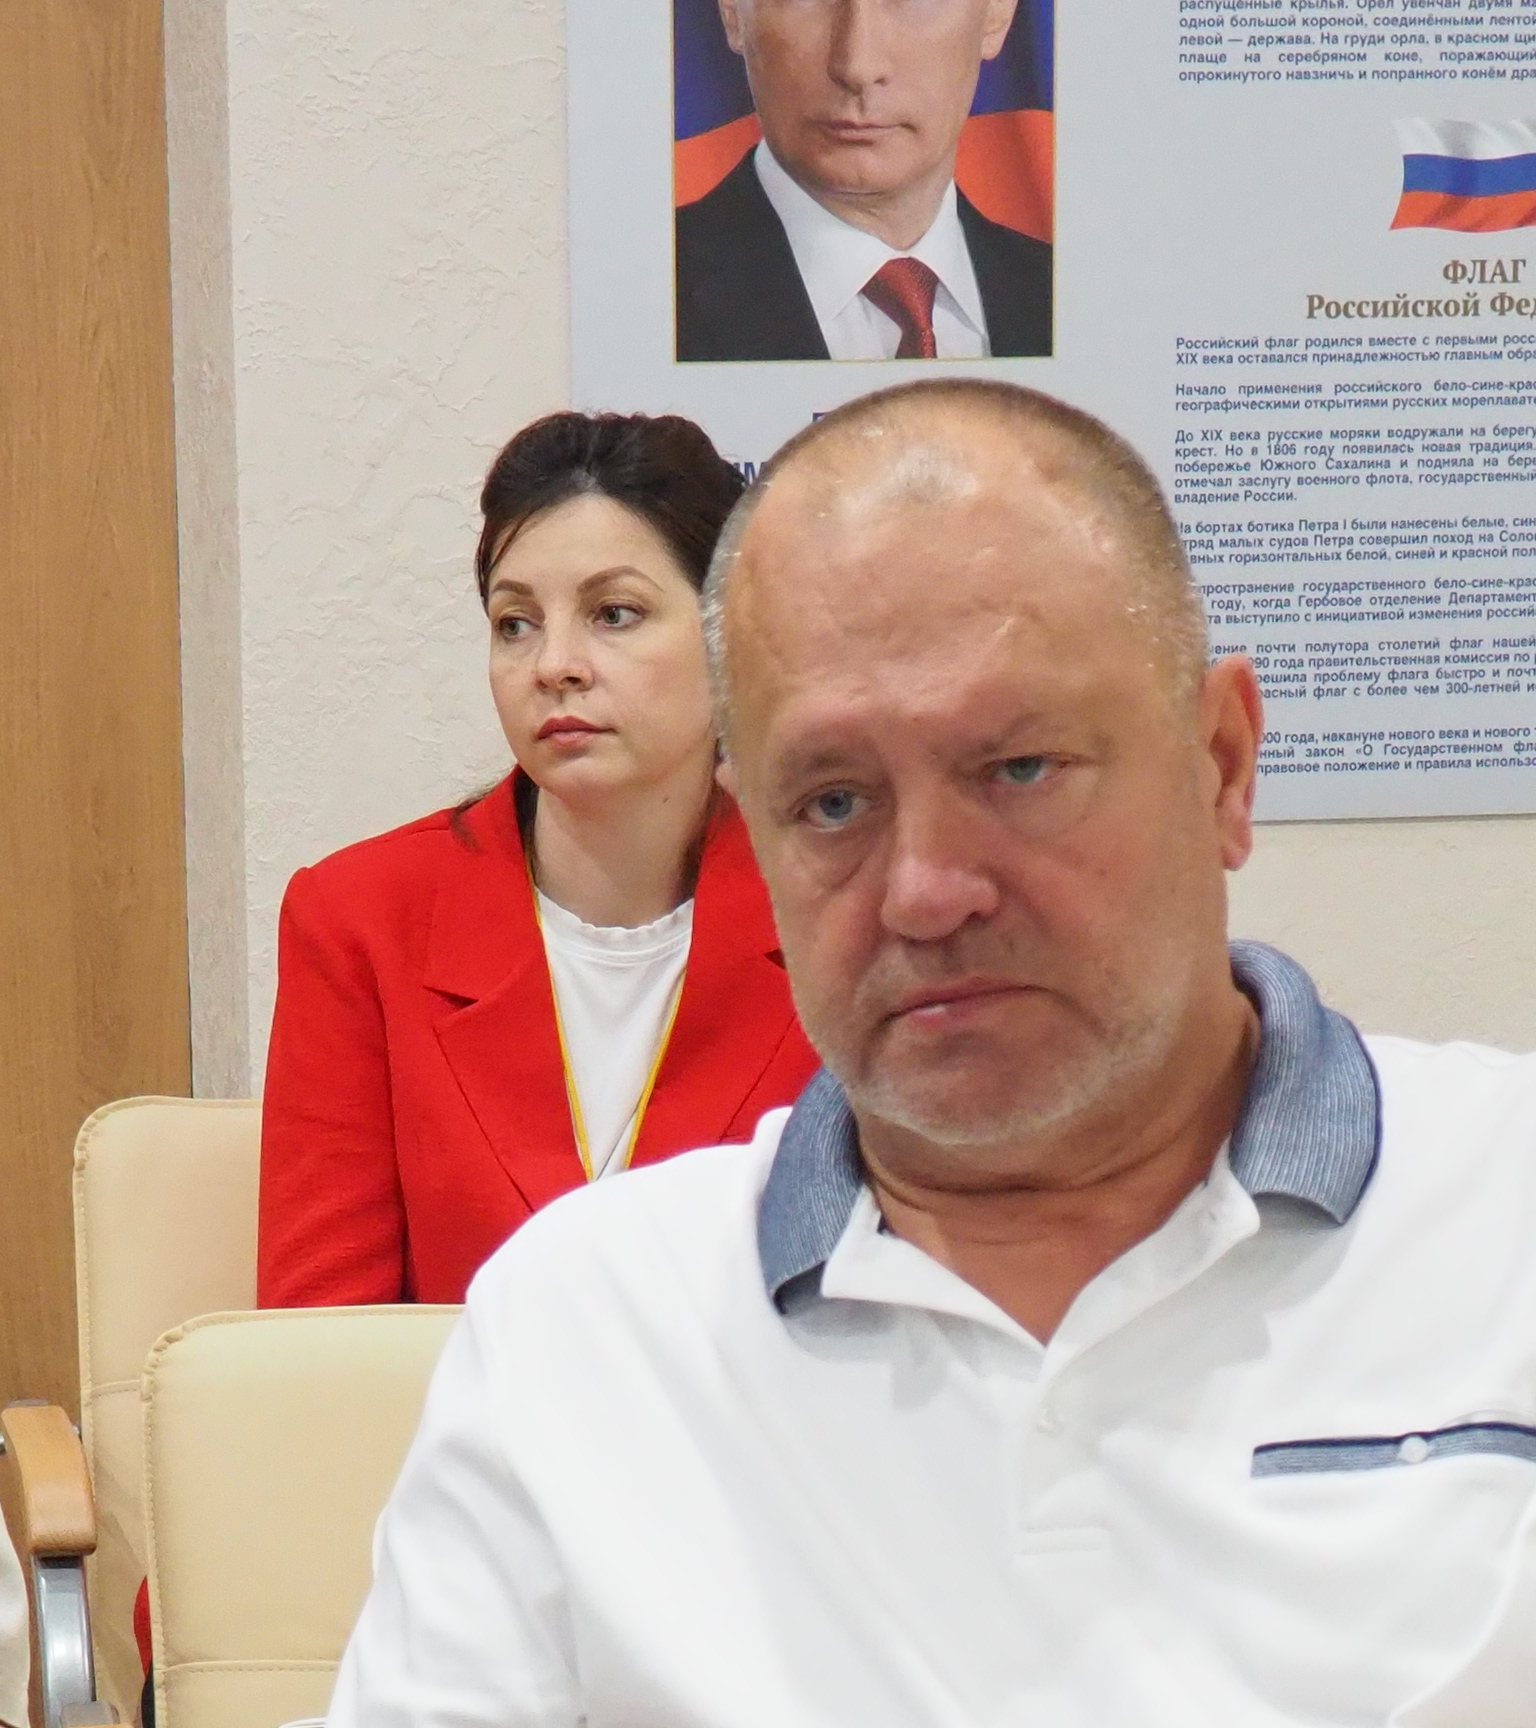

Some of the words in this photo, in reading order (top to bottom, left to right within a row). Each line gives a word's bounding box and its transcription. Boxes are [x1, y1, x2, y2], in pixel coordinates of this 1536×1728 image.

[1178, 52, 1227, 66] плаще
[1244, 52, 1261, 64] на
[1277, 49, 1367, 66] серебряном
[1442, 258, 1527, 285] ФЛАГ
[1306, 291, 1481, 320] Российской
[1175, 335, 1259, 350] Российский
[1264, 335, 1300, 351] флаг
[1304, 336, 1363, 351] родился
[1368, 336, 1417, 347] вместе
[1421, 335, 1430, 346] с
[1435, 335, 1498, 349] первыми
[1175, 352, 1198, 366] XIX
[1202, 354, 1234, 365] века
[1237, 353, 1308, 365] оставался
[1311, 351, 1441, 367] принадлежностью
[1443, 350, 1503, 361] главным
[1175, 398, 1301, 415] географическими
[1304, 398, 1389, 412] открытиями
[1392, 396, 1448, 411] русских
[1323, 760, 1401, 772] положение
[1404, 760, 1413, 770] и
[1415, 758, 1472, 773] правила
